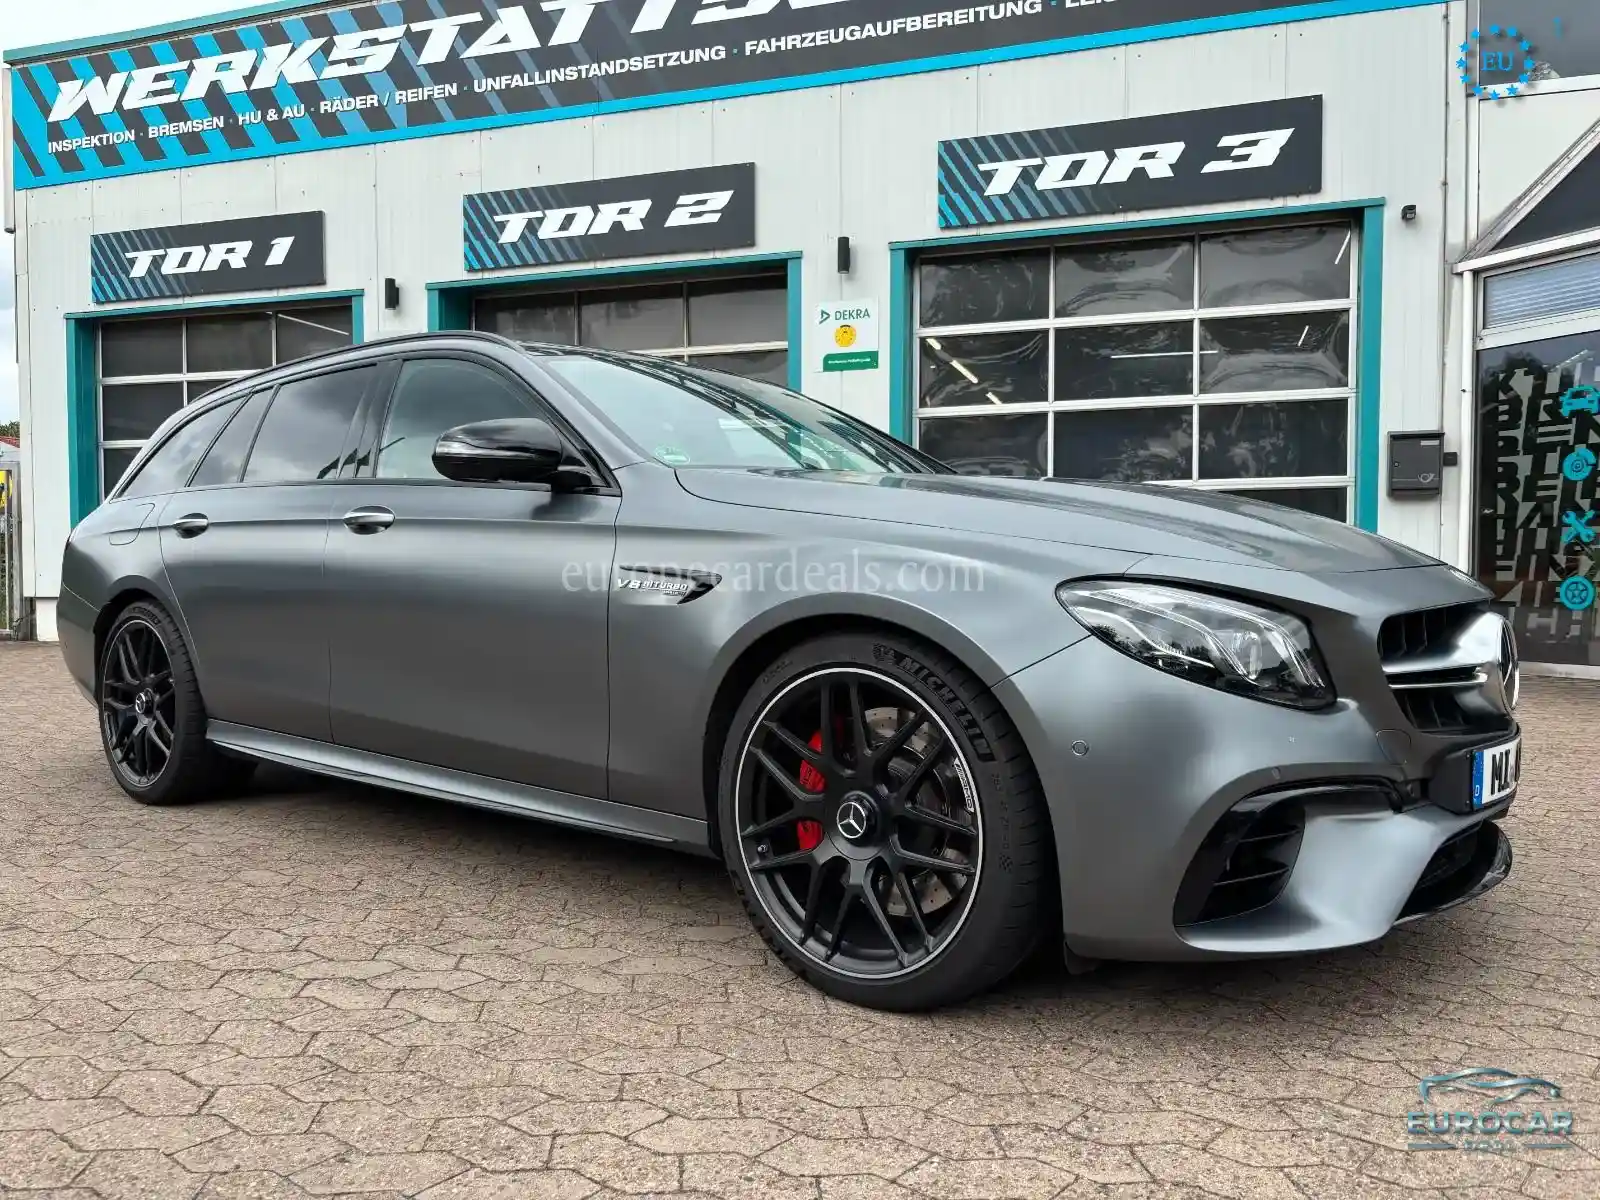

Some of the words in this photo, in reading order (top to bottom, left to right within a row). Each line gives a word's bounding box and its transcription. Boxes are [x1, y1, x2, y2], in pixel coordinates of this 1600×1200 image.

[48, 129, 135, 154] INSPEKTION
[148, 115, 225, 139] BREMSEN
[238, 110, 262, 125] HU
[266, 109, 279, 122] &
[281, 103, 305, 119] AU
[319, 94, 379, 115] RÄDER
[394, 83, 458, 105] REIFEN
[473, 46, 726, 94] UNFALLINSTANDSETZUNG
[744, 0, 1043, 55] FAHRZEUGAUFBEREITUNG
[977, 141, 1186, 197] TOR
[1200, 127, 1296, 175] 3
[493, 198, 653, 245] TOR
[663, 190, 735, 228] 2
[124, 240, 253, 279] TOR
[264, 235, 295, 266] 1
[834, 308, 870, 321] DEKRA
[617, 579, 642, 590] V8
